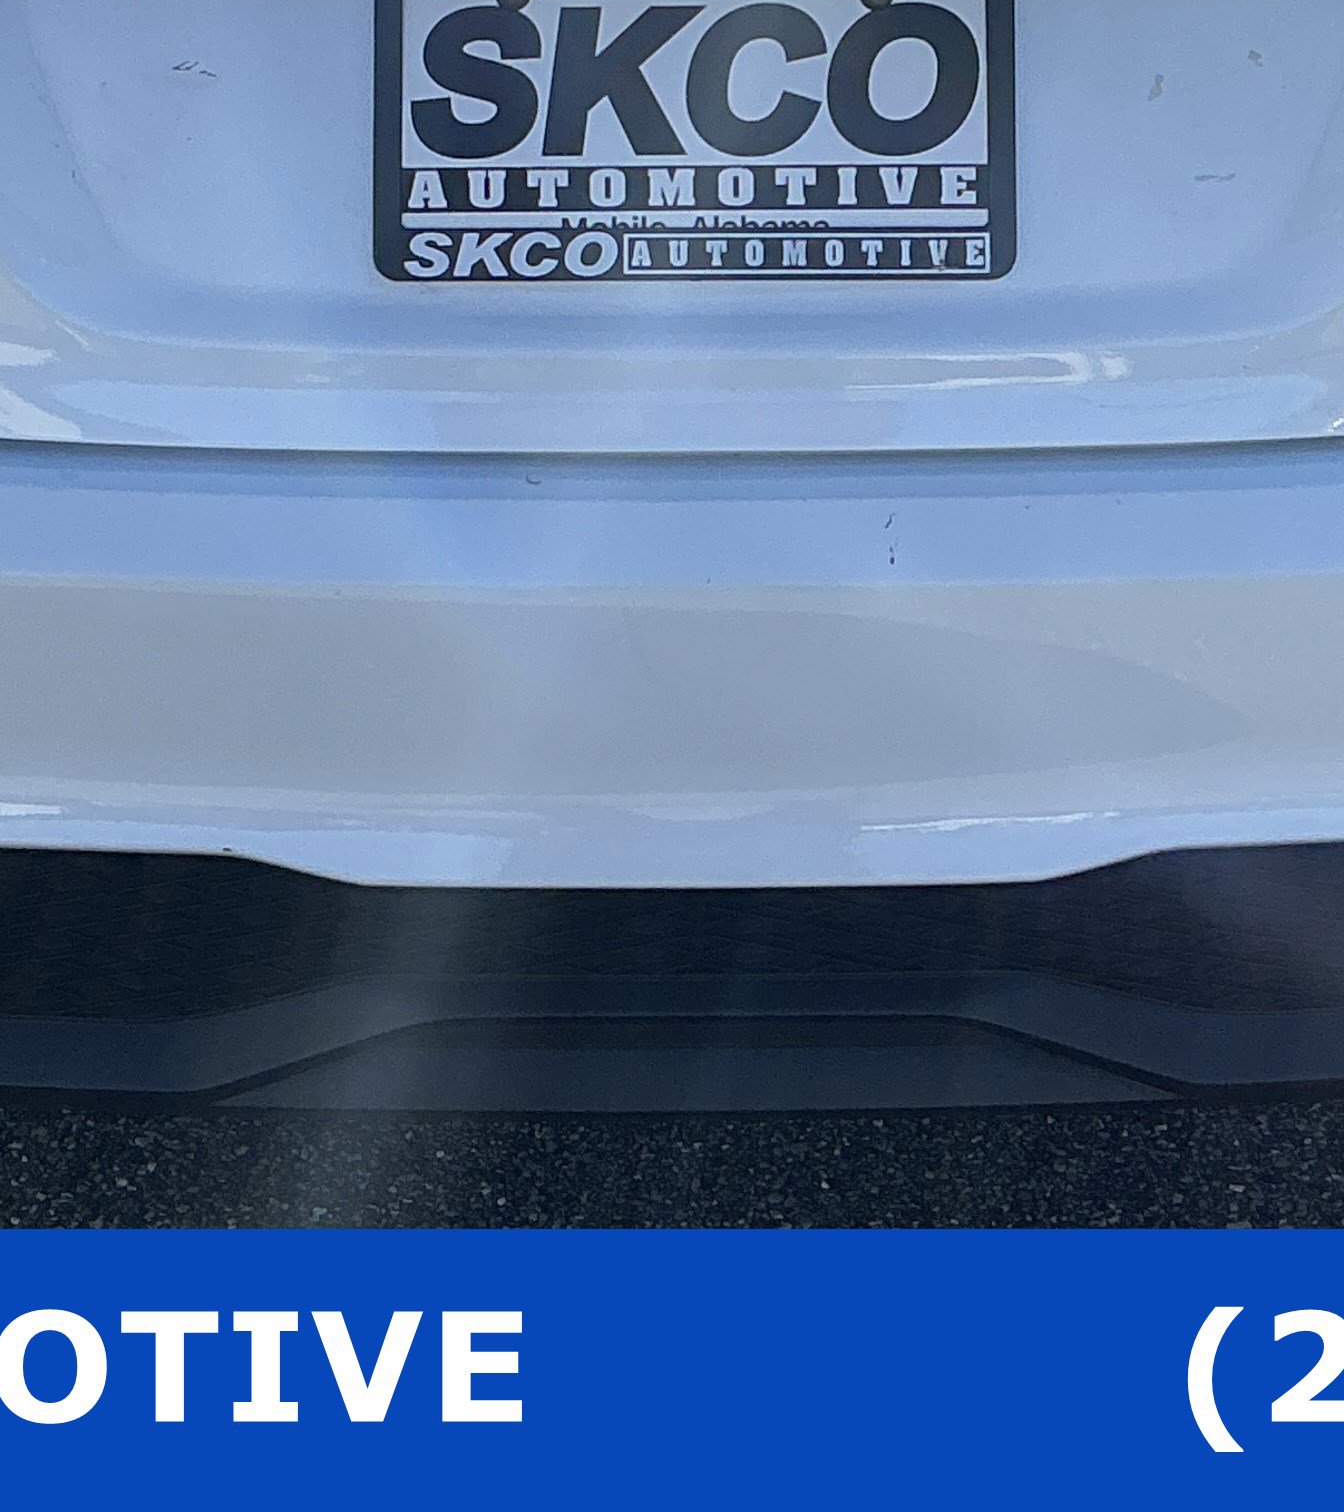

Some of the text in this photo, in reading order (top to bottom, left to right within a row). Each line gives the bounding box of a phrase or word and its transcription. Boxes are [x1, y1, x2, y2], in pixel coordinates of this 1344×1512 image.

[410, 1, 981, 160] SKCO
[407, 167, 978, 209] AUTOMOTIVE
[403, 231, 987, 279] SKCO AUTOMOTIVE
